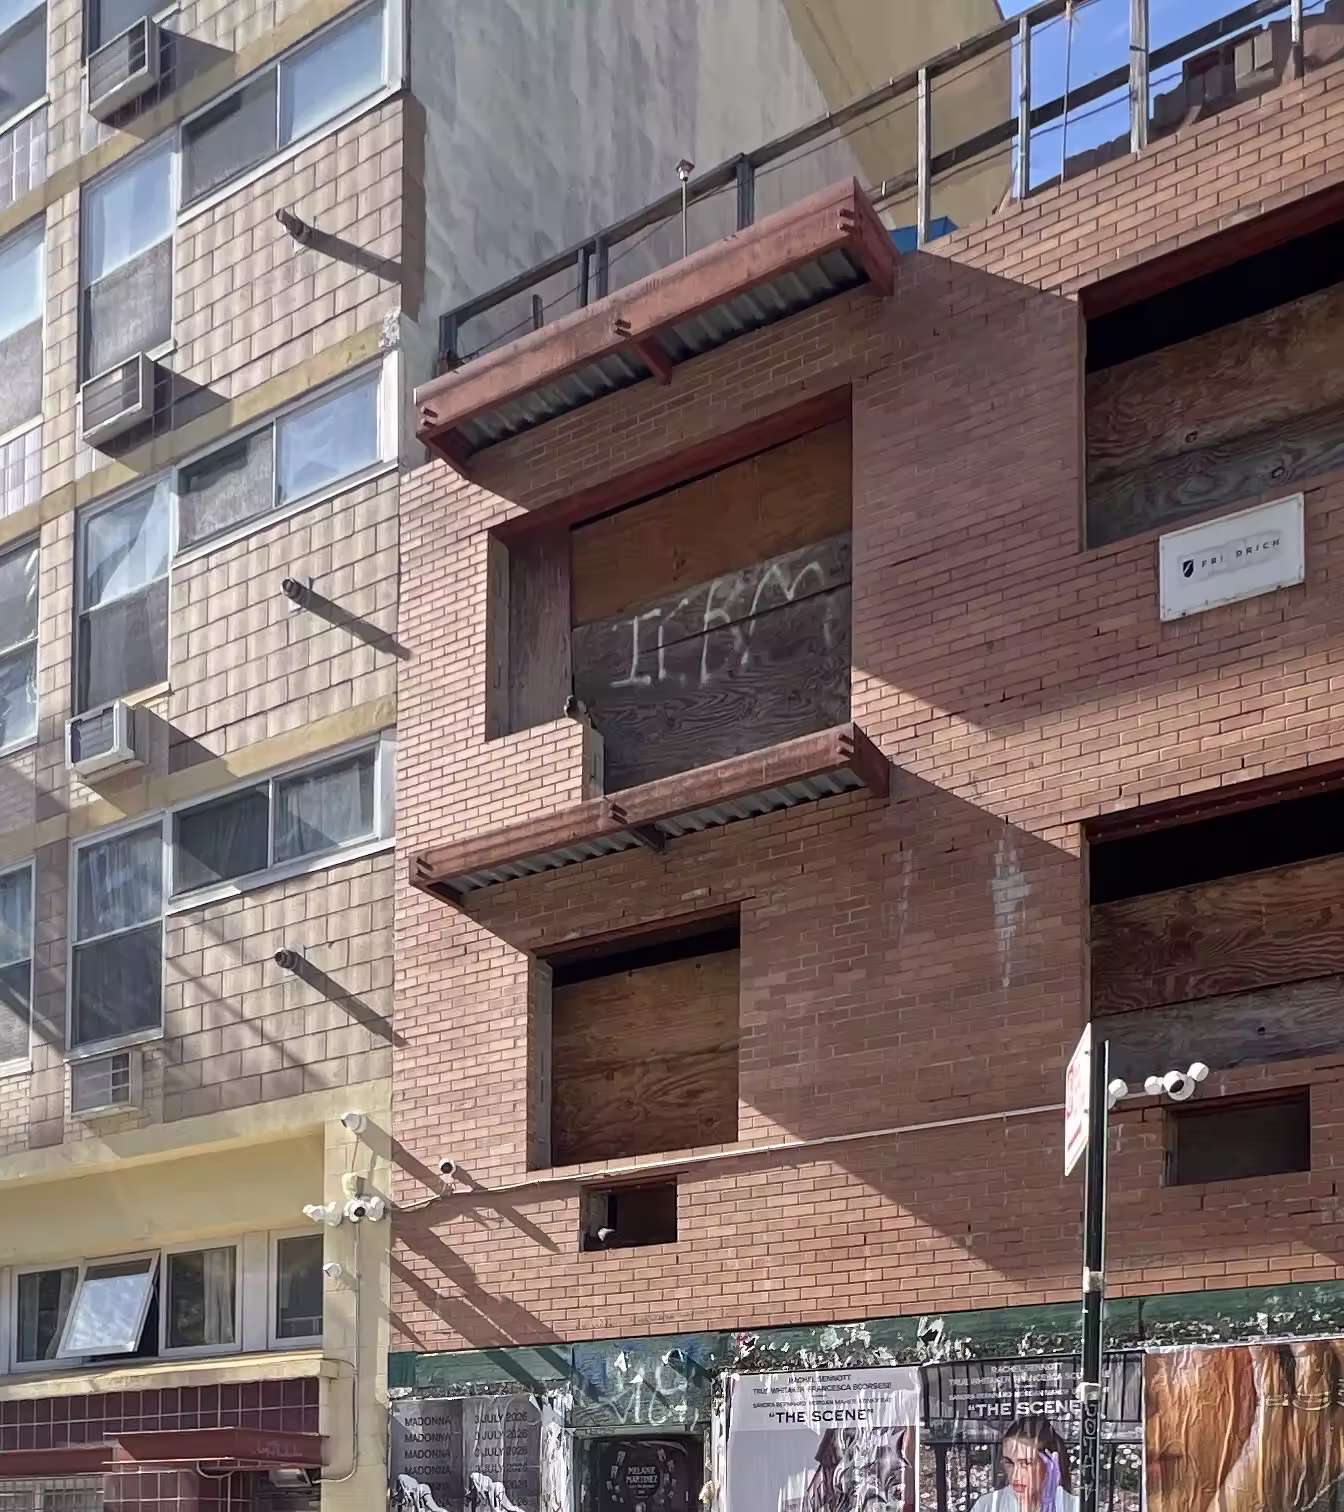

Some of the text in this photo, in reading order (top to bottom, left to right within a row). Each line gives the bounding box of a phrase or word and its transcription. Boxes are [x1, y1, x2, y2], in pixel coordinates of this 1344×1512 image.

[1201, 538, 1279, 568] FRIDRICH
[405, 1417, 451, 1426] MADONNA
[482, 1413, 503, 1423] JULY
[506, 1412, 528, 1422] 2026
[626, 1475, 657, 1483] MARTINEZ
